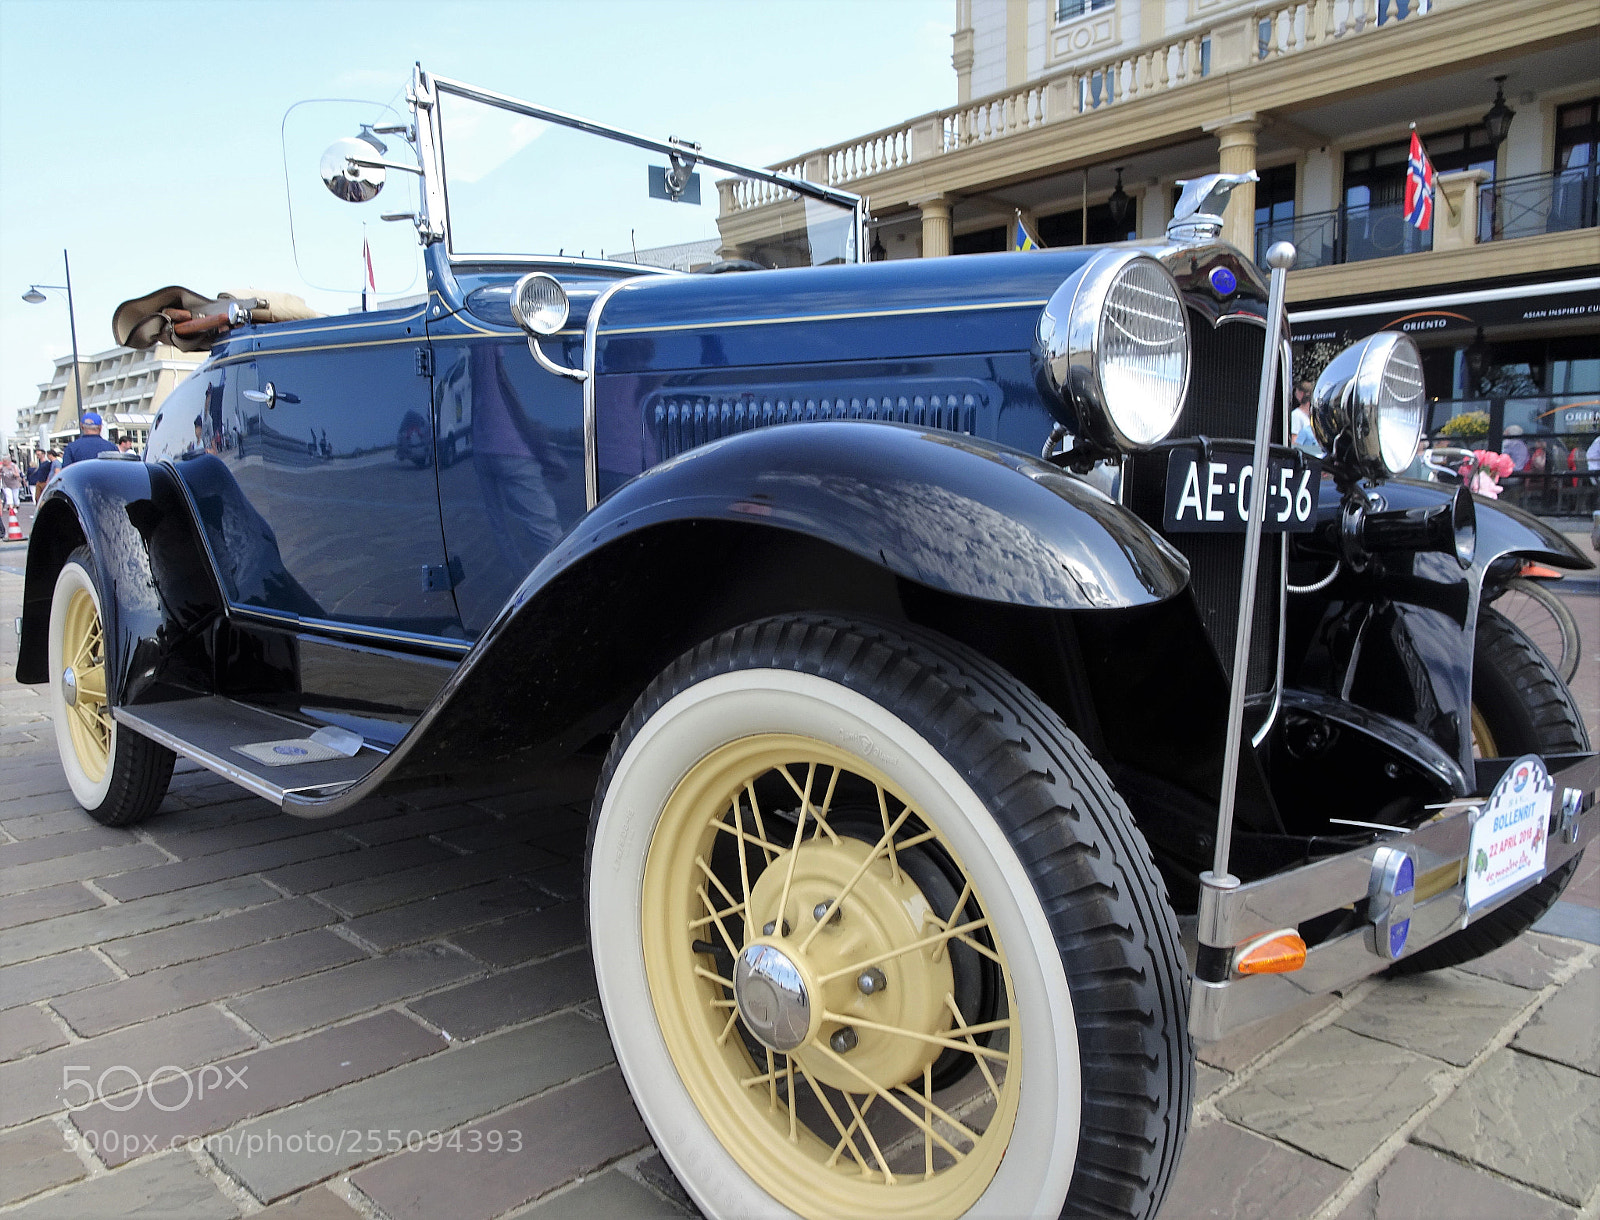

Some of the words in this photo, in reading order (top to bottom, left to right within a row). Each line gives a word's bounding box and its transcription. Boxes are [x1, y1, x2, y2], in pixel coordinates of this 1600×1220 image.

[1523, 310, 1547, 319] ASIAN
[1548, 306, 1585, 317] INSPIRED
[1403, 319, 1447, 331] ORIENTO
[1312, 331, 1336, 340] CUISINE
[1493, 802, 1536, 833] BOLLENRIT
[1489, 842, 1498, 858] 22
[1499, 834, 1517, 854] APRIL
